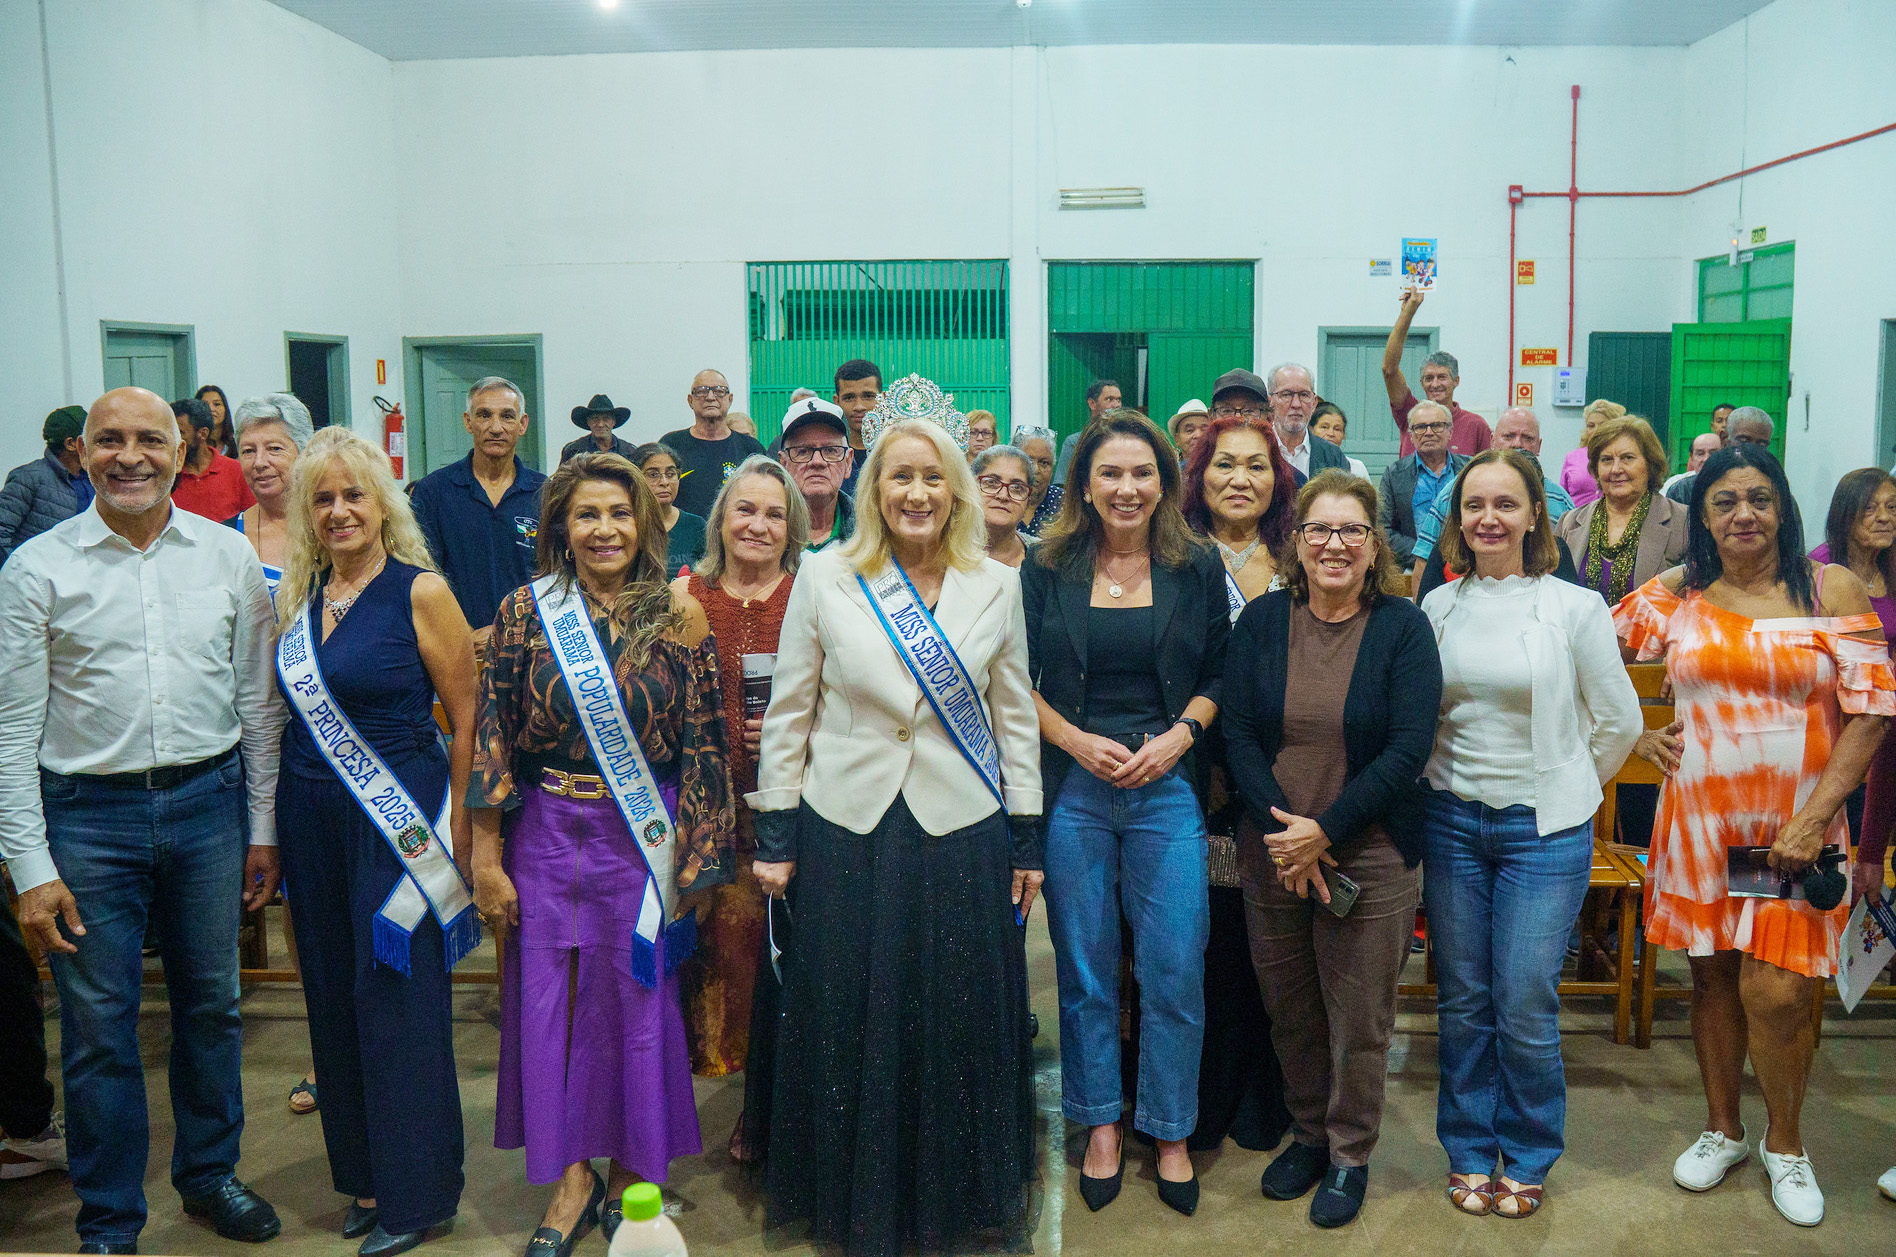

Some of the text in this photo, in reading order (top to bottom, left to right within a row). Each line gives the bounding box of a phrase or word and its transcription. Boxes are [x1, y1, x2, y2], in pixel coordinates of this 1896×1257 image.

[552, 617, 580, 666] UMUARAMA
[563, 610, 580, 630] MISS
[890, 603, 928, 640] MISS
[911, 636, 960, 696] SÊNIOR
[943, 687, 989, 761] UMUARAMA
[308, 700, 380, 790] PRINCESA
[371, 787, 416, 830] 2025
[574, 666, 656, 822] POPULARIDADE 2026
